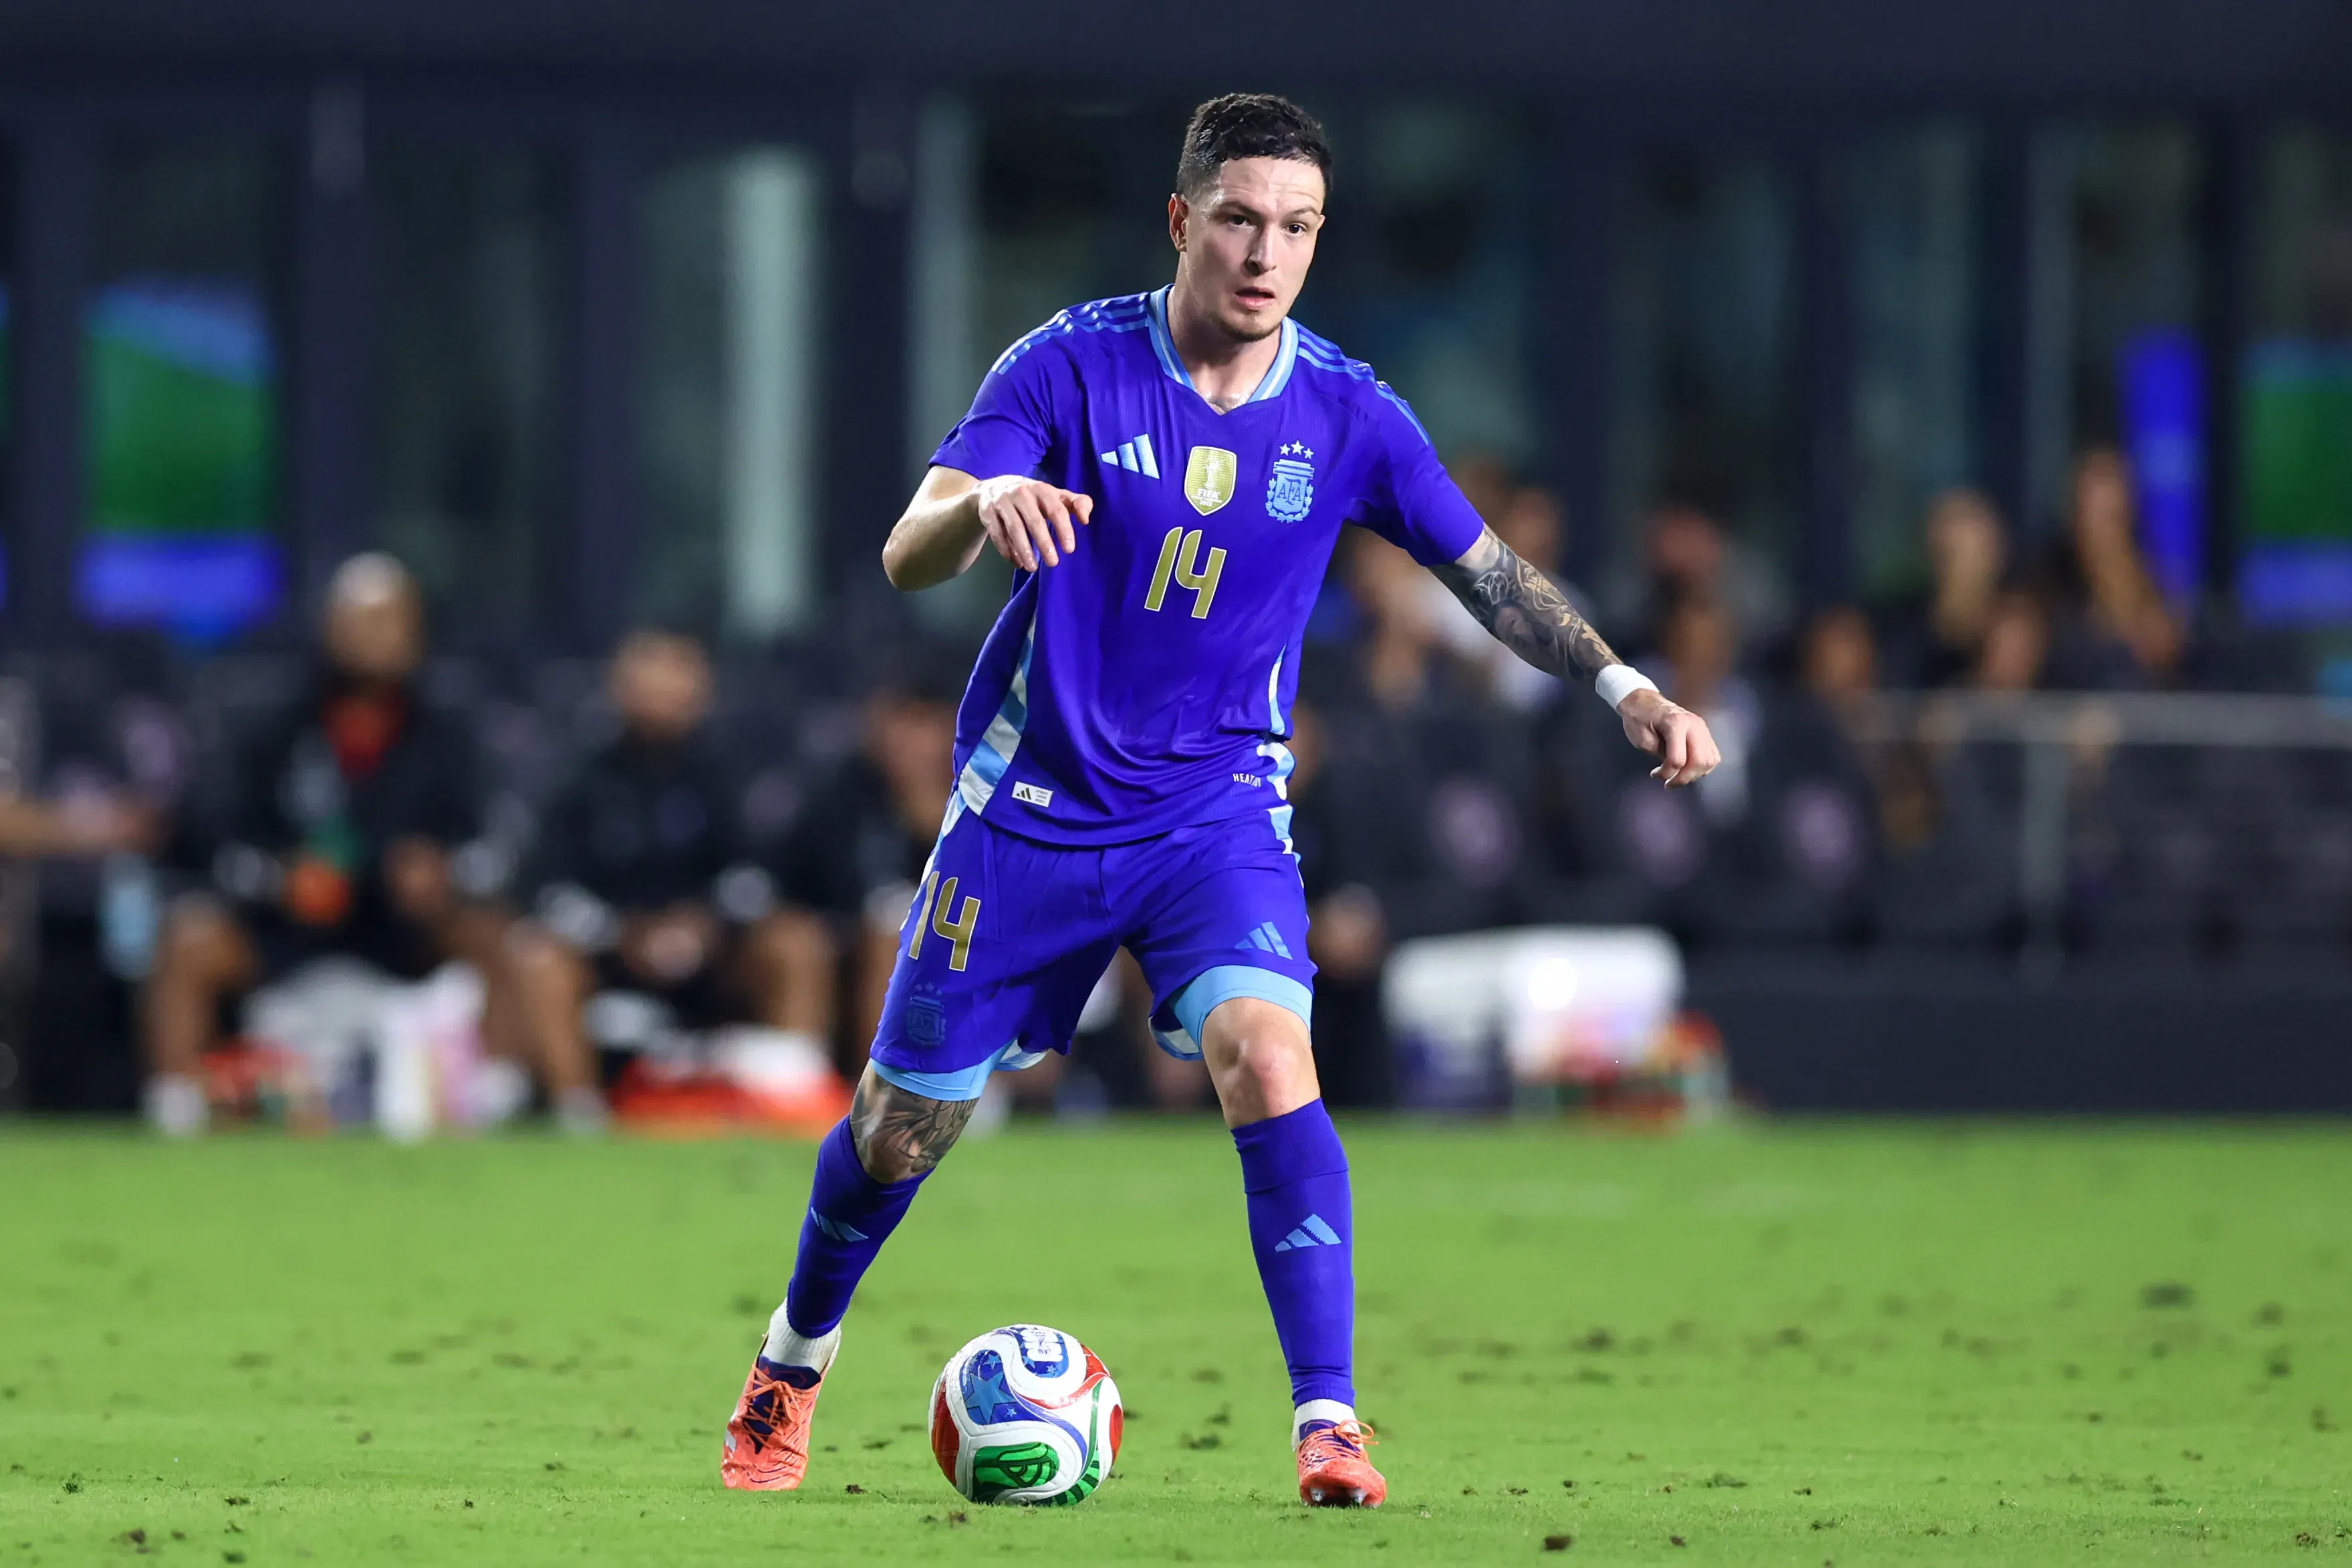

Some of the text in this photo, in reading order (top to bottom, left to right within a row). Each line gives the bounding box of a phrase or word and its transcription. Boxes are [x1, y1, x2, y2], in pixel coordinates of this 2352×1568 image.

[1197, 488, 1219, 499] FIFA
[1277, 477, 1302, 505] AFA
[1144, 526, 1227, 620] 14
[908, 870, 981, 972] 14
